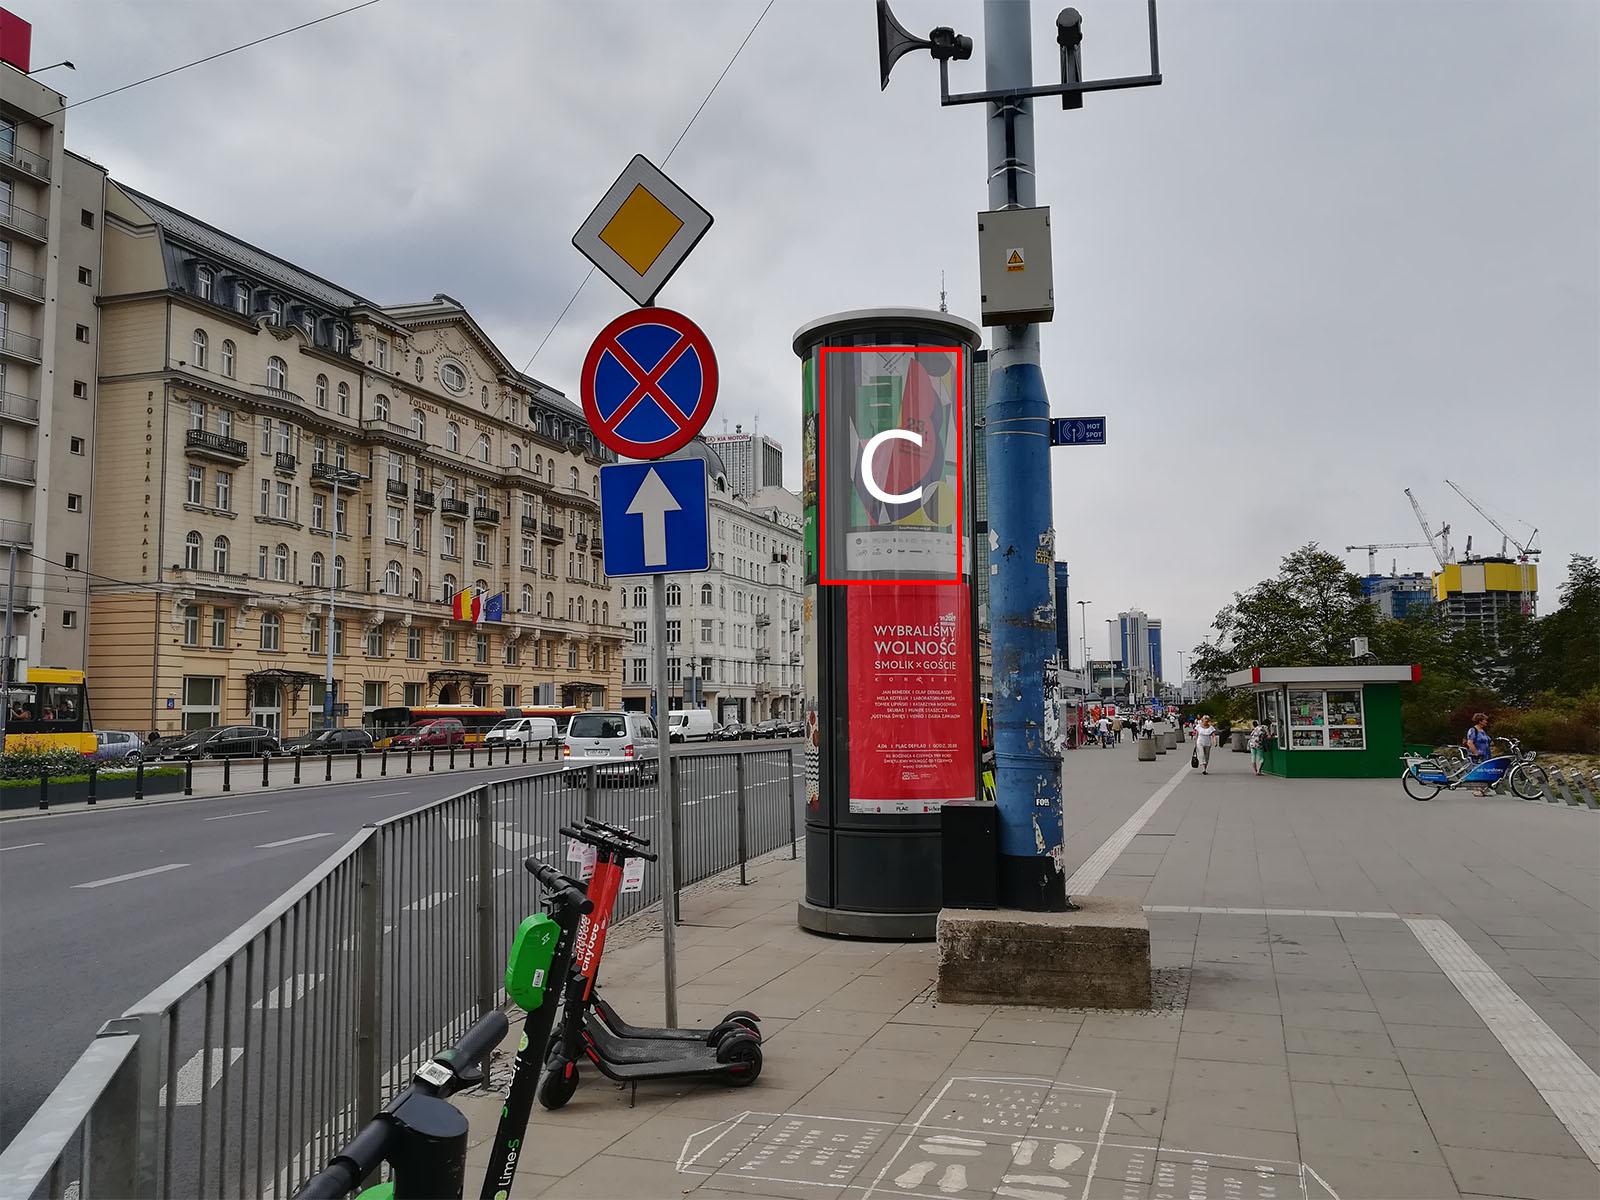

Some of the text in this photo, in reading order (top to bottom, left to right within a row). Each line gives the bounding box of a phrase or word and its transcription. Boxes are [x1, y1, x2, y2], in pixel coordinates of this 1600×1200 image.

[409, 395, 495, 435] POLONIA PALACE HOTEL
[144, 391, 154, 482] POLONIA
[141, 494, 151, 575] PALACE
[873, 622, 956, 637] WYBRALIŚMY
[873, 637, 957, 656] WOLNOŚĆ
[874, 660, 914, 670] SMOLIK
[922, 658, 957, 670] GOŚCIE
[581, 923, 600, 971] citybee
[982, 1116, 1085, 1132] WSCHODU
